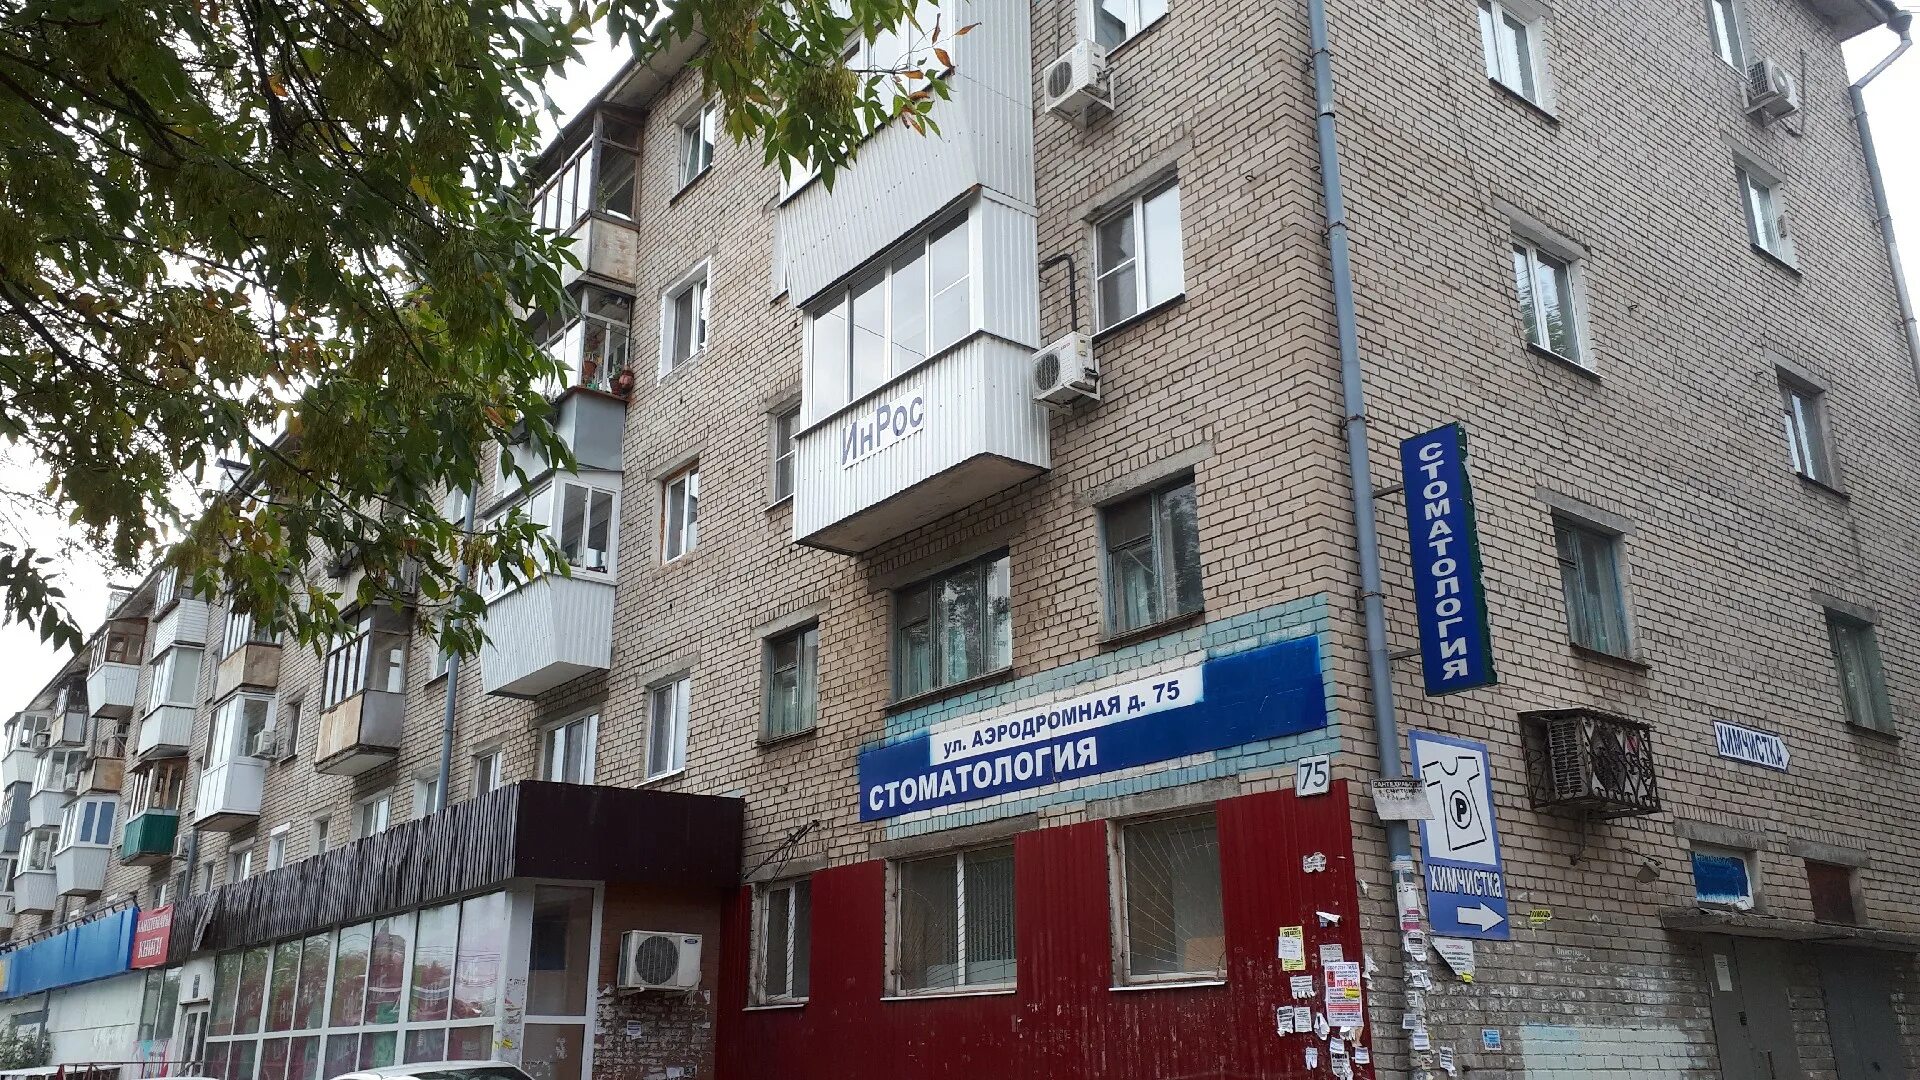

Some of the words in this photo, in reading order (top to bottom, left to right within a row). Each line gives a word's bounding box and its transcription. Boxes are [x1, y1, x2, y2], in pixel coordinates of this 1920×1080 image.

[1419, 442, 1469, 681] СТОМАТОЛОГИЯ
[943, 740, 967, 760] ул.
[972, 695, 1121, 748] АЭРОДРОМНАЯ
[1127, 694, 1146, 715] д.
[1152, 679, 1181, 704] 75
[1716, 724, 1785, 768] ХИМЧИСТКА
[868, 736, 1098, 812] СТОМАТОЛОГИЯ
[1300, 760, 1327, 790] 75
